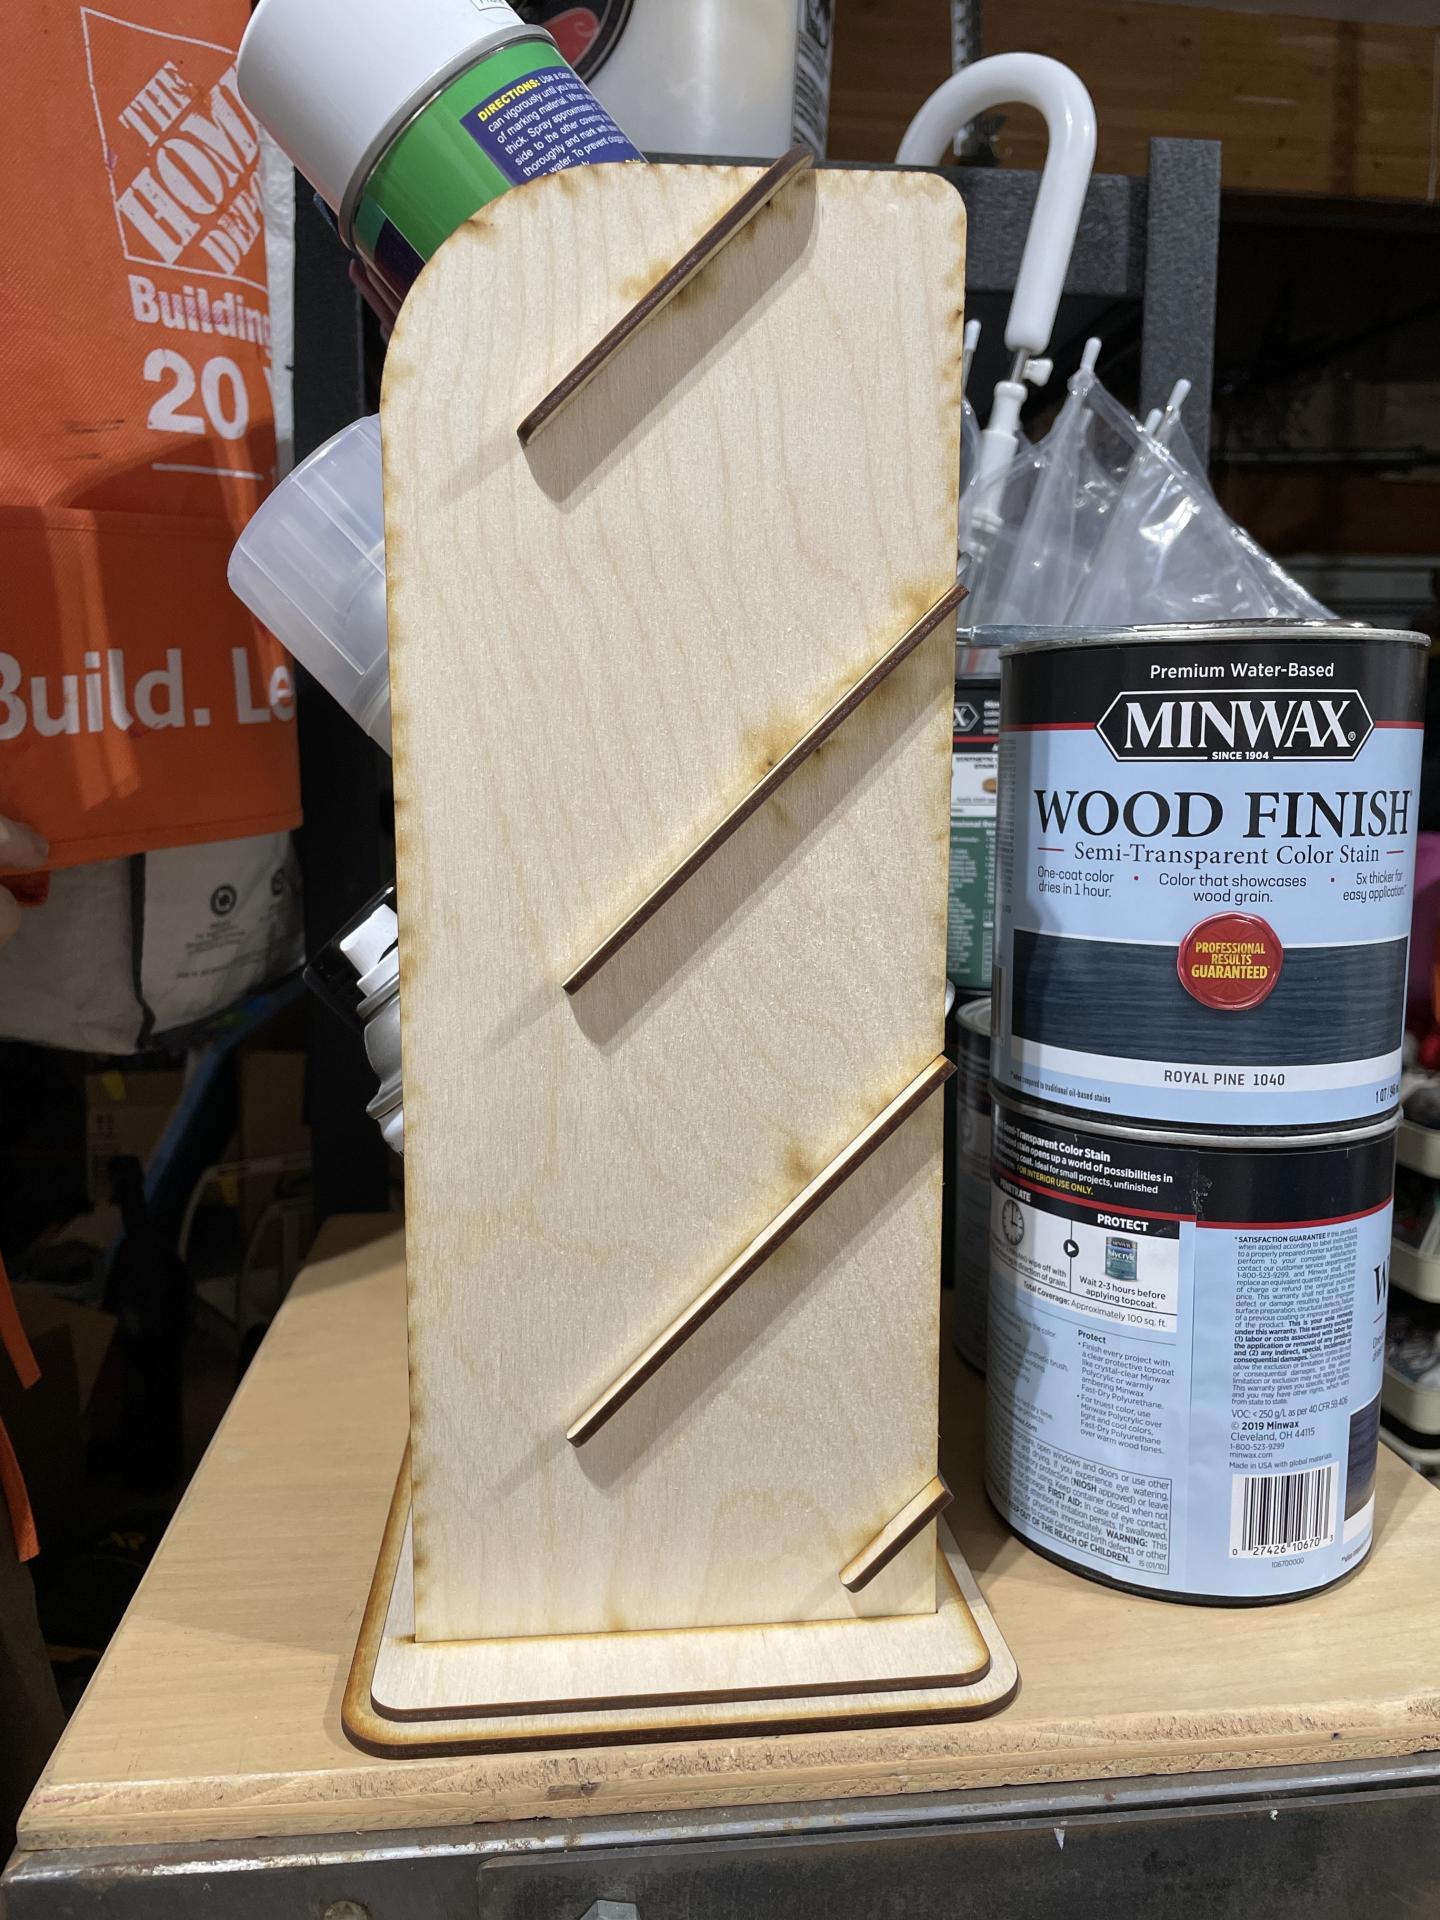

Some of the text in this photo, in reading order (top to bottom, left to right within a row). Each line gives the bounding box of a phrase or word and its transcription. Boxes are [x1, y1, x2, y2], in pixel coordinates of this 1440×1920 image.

[118, 61, 194, 147] THE
[478, 79, 541, 122] DIRECTIONS:
[488, 86, 556, 132] can vigorously until
[497, 97, 568, 143] of marking material.
[504, 104, 595, 155] thick. Spray approximately
[514, 121, 578, 165] side to the other
[523, 126, 597, 176] thoroughly and mark
[572, 138, 608, 158] To prevent
[118, 65, 258, 265] HOM
[143, 349, 249, 440] 20
[1150, 662, 1334, 679] Premium Water-Based
[0, 648, 210, 740] Build.
[1124, 701, 1351, 749] MINWAX
[1212, 751, 1269, 759] SINCE 1904
[1034, 790, 1410, 838] WOOD FINISH
[1074, 841, 1380, 870] Semi-Transparent Color Stain
[1037, 865, 1115, 883] One-coat color
[1159, 873, 1307, 887] Color that showcases
[1356, 871, 1394, 885] 5x thicker
[1039, 880, 1112, 898] dries in hour.
[1193, 889, 1273, 905] wood grain.
[1343, 890, 1366, 903] easy
[1196, 942, 1266, 954] PROFESSIONAL
[1211, 954, 1252, 965] RESULTS
[1164, 1069, 1285, 1086] ROYAL PINE 1040
[1044, 1082, 1093, 1101] traditional oil-based
[1059, 1142, 1111, 1162] Color Stain
[1030, 1148, 1173, 1183] opens up world of possibilities in
[1027, 1169, 1093, 1196] INTERIOR USE ONLY.
[1034, 1160, 1158, 1194] Ideal for small projects, unfinished
[1097, 1213, 1149, 1232] PROTECT
[1258, 1243, 1281, 1251] applied
[1283, 1242, 1311, 1250] according
[1289, 1233, 1326, 1242] GUARANTEE
[1042, 1264, 1066, 1277] off with
[1049, 1277, 1067, 1288] grain.
[1079, 1275, 1166, 1300] Wait 2-3 hours before
[1037, 1287, 1167, 1327] Coverage: Approximately 100 sq. ft.
[1086, 1288, 1158, 1309] applying topcoat.
[1078, 1329, 1106, 1344] Protect
[1082, 1341, 1171, 1367] Finish every project with
[1082, 1359, 1170, 1384] like crystal-clear Minwax
[1086, 1352, 1175, 1377] clear protective topcoat
[1081, 1367, 1153, 1392] Polycrylic warmly
[1081, 1377, 1144, 1397] ambering Minwax
[1081, 1384, 1164, 1410] Fast-Dry Polyurethane.
[1081, 1394, 1136, 1417] For truest color,
[1080, 1403, 1144, 1426] Minwax Polycrylic
[1260, 1409, 1287, 1419] 250 g/L
[1080, 1420, 1161, 1445] Fast-Dry Polyurethane
[1094, 1415, 1154, 1435] and cool colors,
[1231, 1427, 1315, 1441] Cleveland, OH 44115
[1242, 1421, 1299, 1430] 2019 Minwax
[1096, 1432, 1164, 1454] warm wood tones.
[1230, 1443, 1285, 1451] 1-800-523-9299
[1053, 1452, 1169, 1490] windows doors other
[1258, 1461, 1272, 1469] USA
[1289, 1458, 1308, 1468] global
[1047, 1486, 1083, 1507] FIRST AID:
[1106, 1529, 1148, 1547] WARNING:
[1126, 1526, 1168, 1541] swallowed,
[1054, 1528, 1131, 1564] REACH CHILDREN.
[1253, 1537, 1320, 1556] 27426 10670
[1271, 1558, 1305, 1568] 106700000
